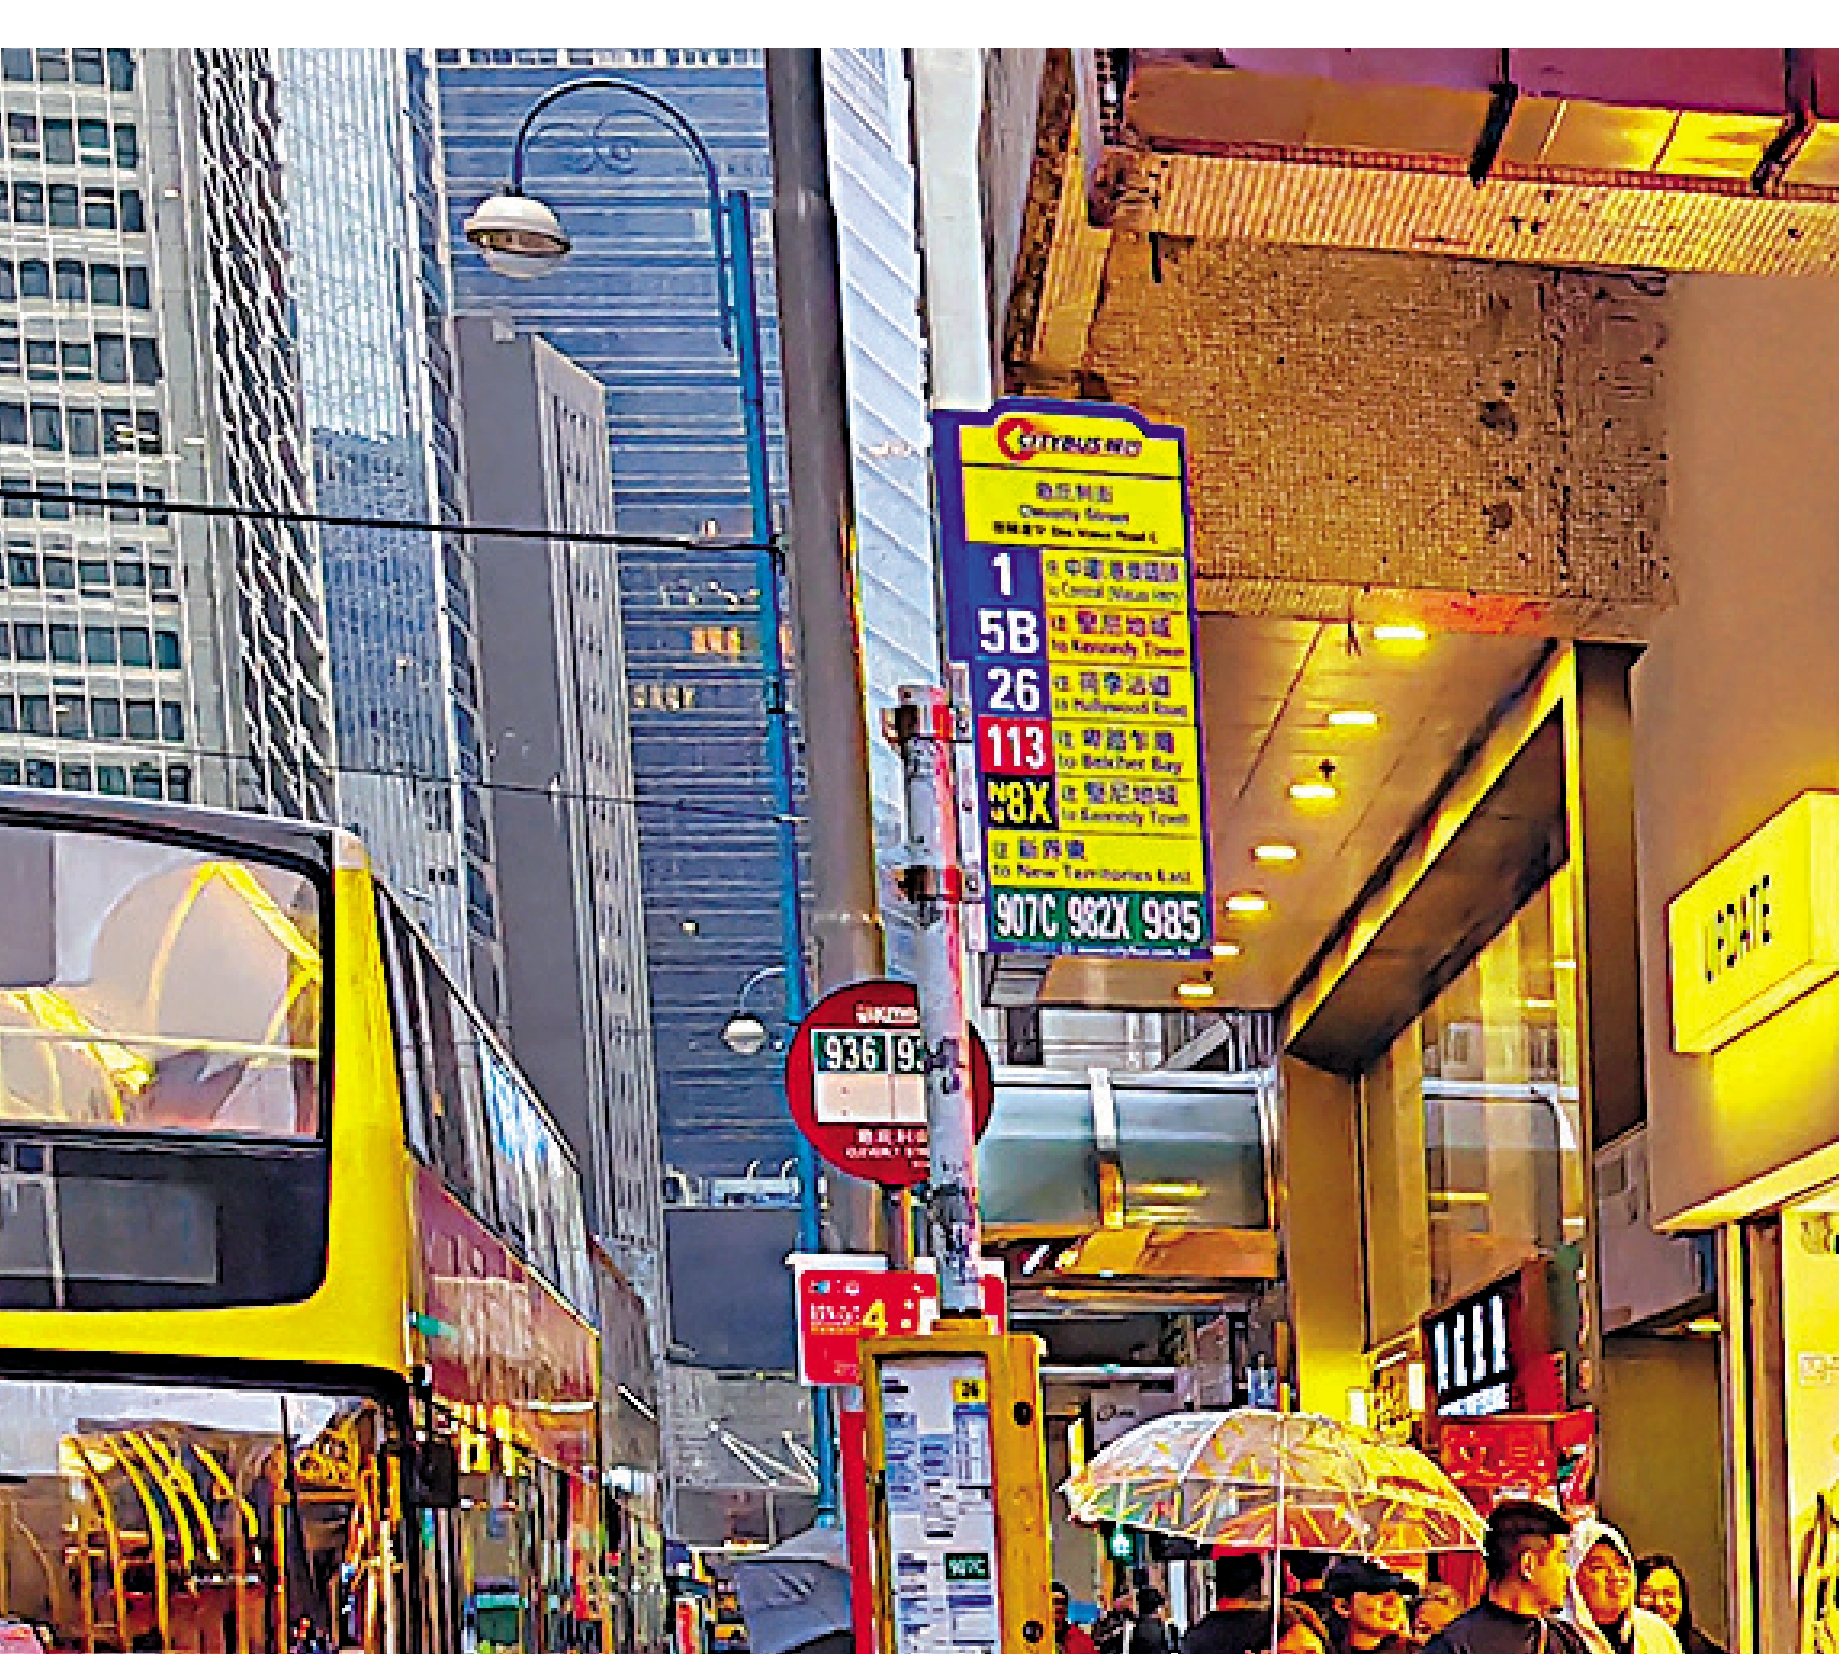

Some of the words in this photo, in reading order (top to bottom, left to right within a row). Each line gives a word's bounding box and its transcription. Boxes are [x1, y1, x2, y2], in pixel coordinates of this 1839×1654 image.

[993, 552, 1012, 596] 1
[978, 608, 1040, 654] 5B
[988, 669, 1041, 711] 26
[988, 724, 1046, 767] 113
[997, 894, 1058, 937] 907C
[1068, 897, 1130, 939] 982X
[1142, 901, 1202, 942] 985
[824, 1035, 879, 1071] 936
[861, 1298, 887, 1336] 4
